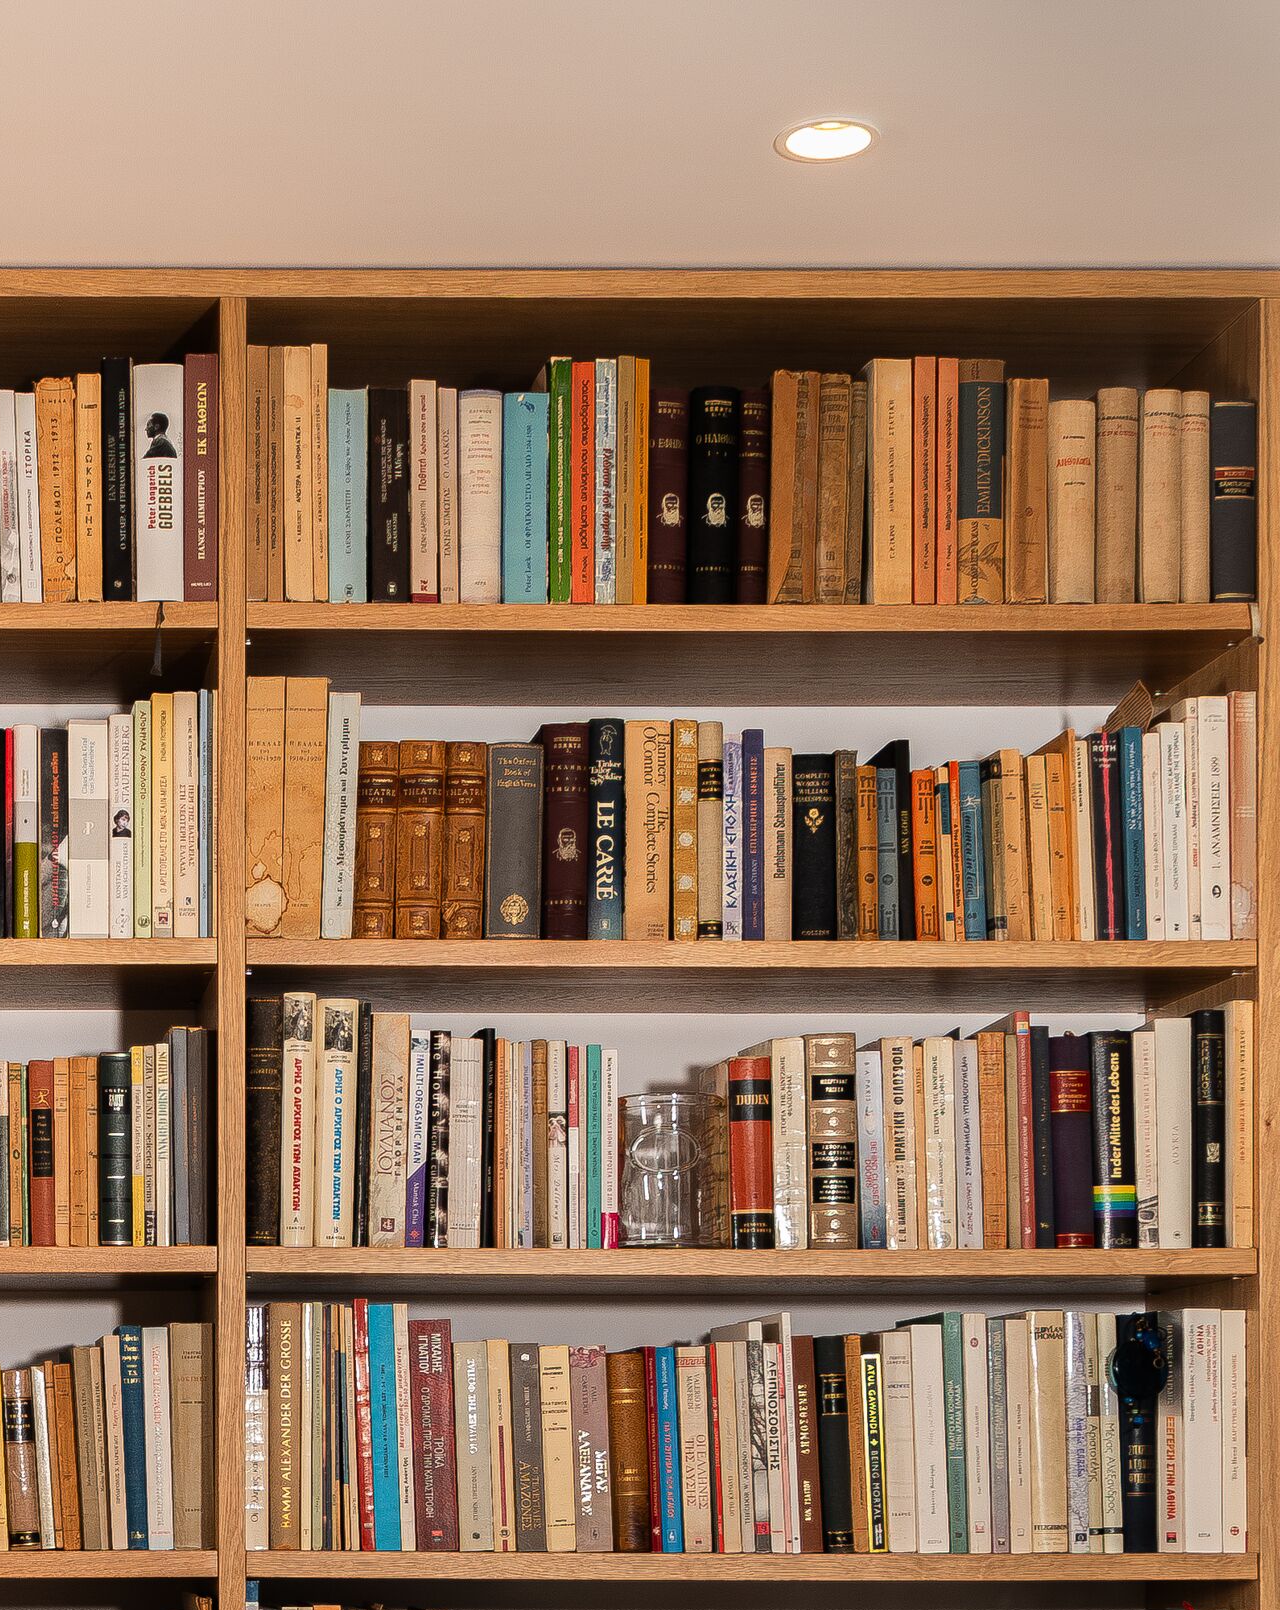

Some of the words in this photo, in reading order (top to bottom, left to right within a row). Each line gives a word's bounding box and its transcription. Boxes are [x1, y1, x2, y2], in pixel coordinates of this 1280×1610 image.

[197, 382, 207, 433] ΒΑΘΕΩΝ
[977, 387, 991, 465] DICKINSON
[23, 430, 33, 478] ΙΣΤΟΡΙΚΑ
[197, 438, 207, 455] ΕΚ
[85, 443, 94, 536] ΣΩΚΡΑΤΗΣ
[147, 466, 157, 505] Longerich
[158, 465, 173, 529] GOEBBELS
[197, 470, 206, 525] ΔΗΜΗΤΡΙΟΥ
[976, 469, 992, 512] EMILY
[147, 508, 156, 529] Peter
[197, 528, 206, 559] ΠΑΝΟΣ
[121, 725, 130, 803] STAUFFENBERG
[657, 733, 669, 786] Flannery
[596, 800, 615, 828] LE
[773, 764, 787, 828] Schauspielführer
[644, 792, 659, 849] Complete
[658, 807, 669, 830] The
[596, 835, 618, 900] CARRÉ
[646, 853, 659, 893] Stories
[774, 831, 785, 879] Bertelsmann
[294, 1058, 302, 1084] ΑΡΗΣ
[1109, 1053, 1120, 1093] Lebens
[413, 1057, 425, 1138] MULTI-ORGASMIC
[735, 1094, 768, 1105] DUDEN
[1110, 1094, 1121, 1115] des
[293, 1096, 302, 1140] ΑΡΧΗΓΟΣ
[377, 1075, 395, 1176] ΙΟΥΛΙΑΝΟΣ
[1110, 1117, 1121, 1146] Mitte
[293, 1143, 302, 1163] ΤΩΝ
[413, 1141, 421, 1163] MAN
[1111, 1147, 1122, 1167] der
[293, 1166, 301, 1210] ΑΤΑΚΤΩΝ
[1111, 1167, 1122, 1179] In
[418, 1334, 429, 1374] ΙΓΝΑΤΙΟΥ
[431, 1333, 442, 1372] ΜΙΧΑΛΗΣ
[866, 1364, 876, 1385] ATUL
[798, 1384, 810, 1455] ΔΗΜΟΣΘΕΝΗΣ
[868, 1389, 878, 1433] GAWANDE
[685, 1438, 695, 1462] ΤΗΣ
[697, 1434, 706, 1446] ΟΙ
[1167, 1416, 1175, 1459] ΕΞΕΓΕΡΣΗ
[595, 1450, 608, 1493] ΜΕΓΑΣ
[697, 1449, 708, 1509] ΕΛΛΗΝΕΣ
[871, 1450, 879, 1478] BEING
[1167, 1463, 1175, 1485] ΣΤΗΝ
[520, 1460, 532, 1530] ΑΜΑΖΟΝΕΣ
[686, 1465, 696, 1506] ΔΥΣΗΣ
[873, 1481, 882, 1519] MORTAL
[1167, 1488, 1175, 1519] ΑΘΗΝΑ
